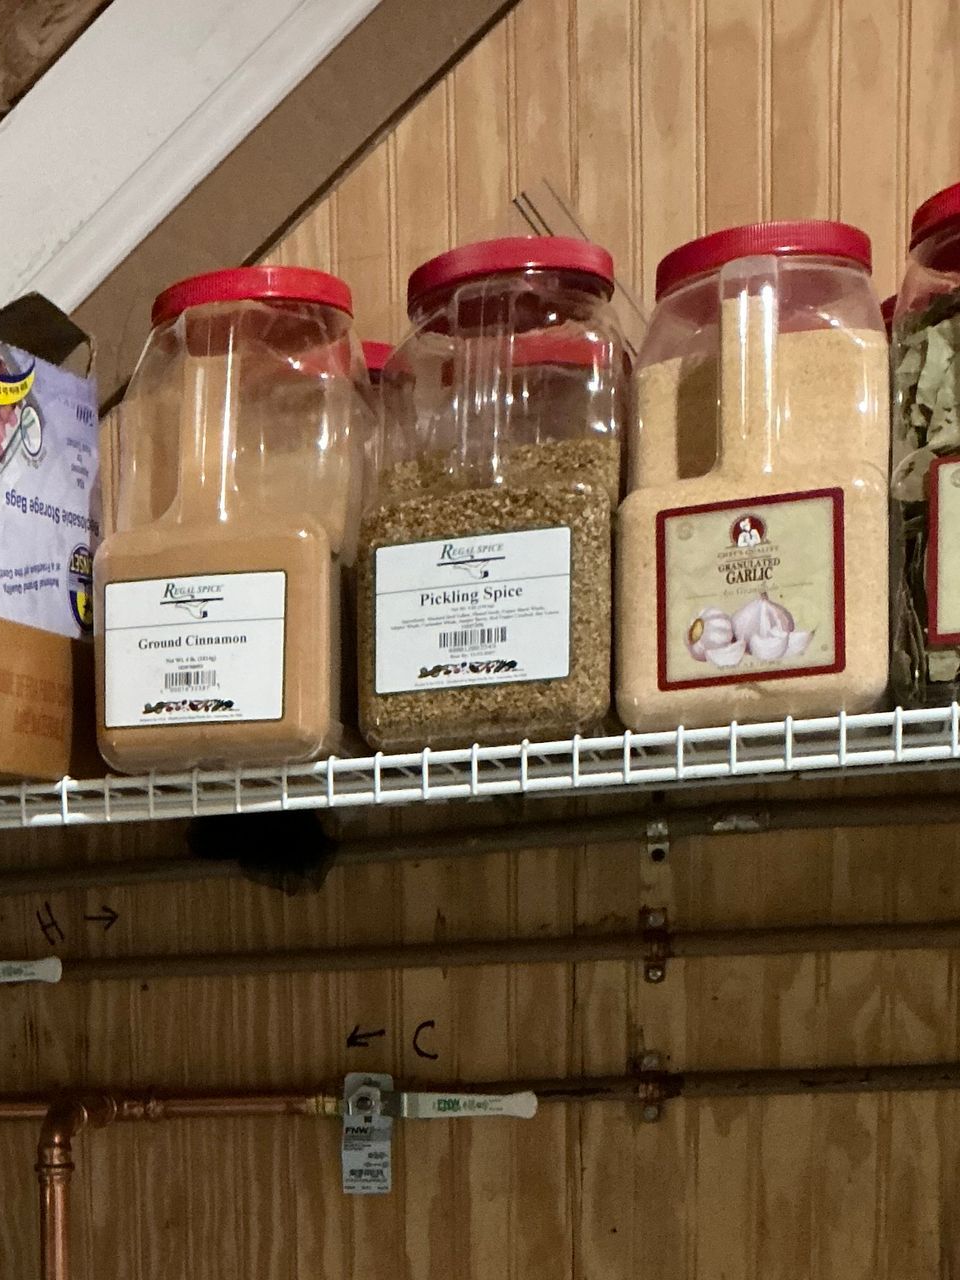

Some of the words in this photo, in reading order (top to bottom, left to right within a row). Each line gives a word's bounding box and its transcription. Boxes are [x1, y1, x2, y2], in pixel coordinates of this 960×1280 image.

[5, 488, 28, 514] Bags
[30, 496, 60, 525] Storage
[62, 509, 100, 537] Reclosable
[440, 543, 474, 560] REGAL
[477, 543, 504, 553] SPICE
[717, 557, 781, 573] GRANULATED
[726, 566, 773, 585] GARLIC
[163, 582, 196, 599] REGAL
[197, 584, 223, 595] SPICE
[420, 589, 479, 607] Pickling
[483, 585, 523, 603] Spice
[138, 636, 182, 651] Ground
[185, 633, 248, 647] Cinnamon
[36, 903, 66, 945] H
[412, 1019, 439, 1060] C
[345, 1126, 368, 1135] FNW
